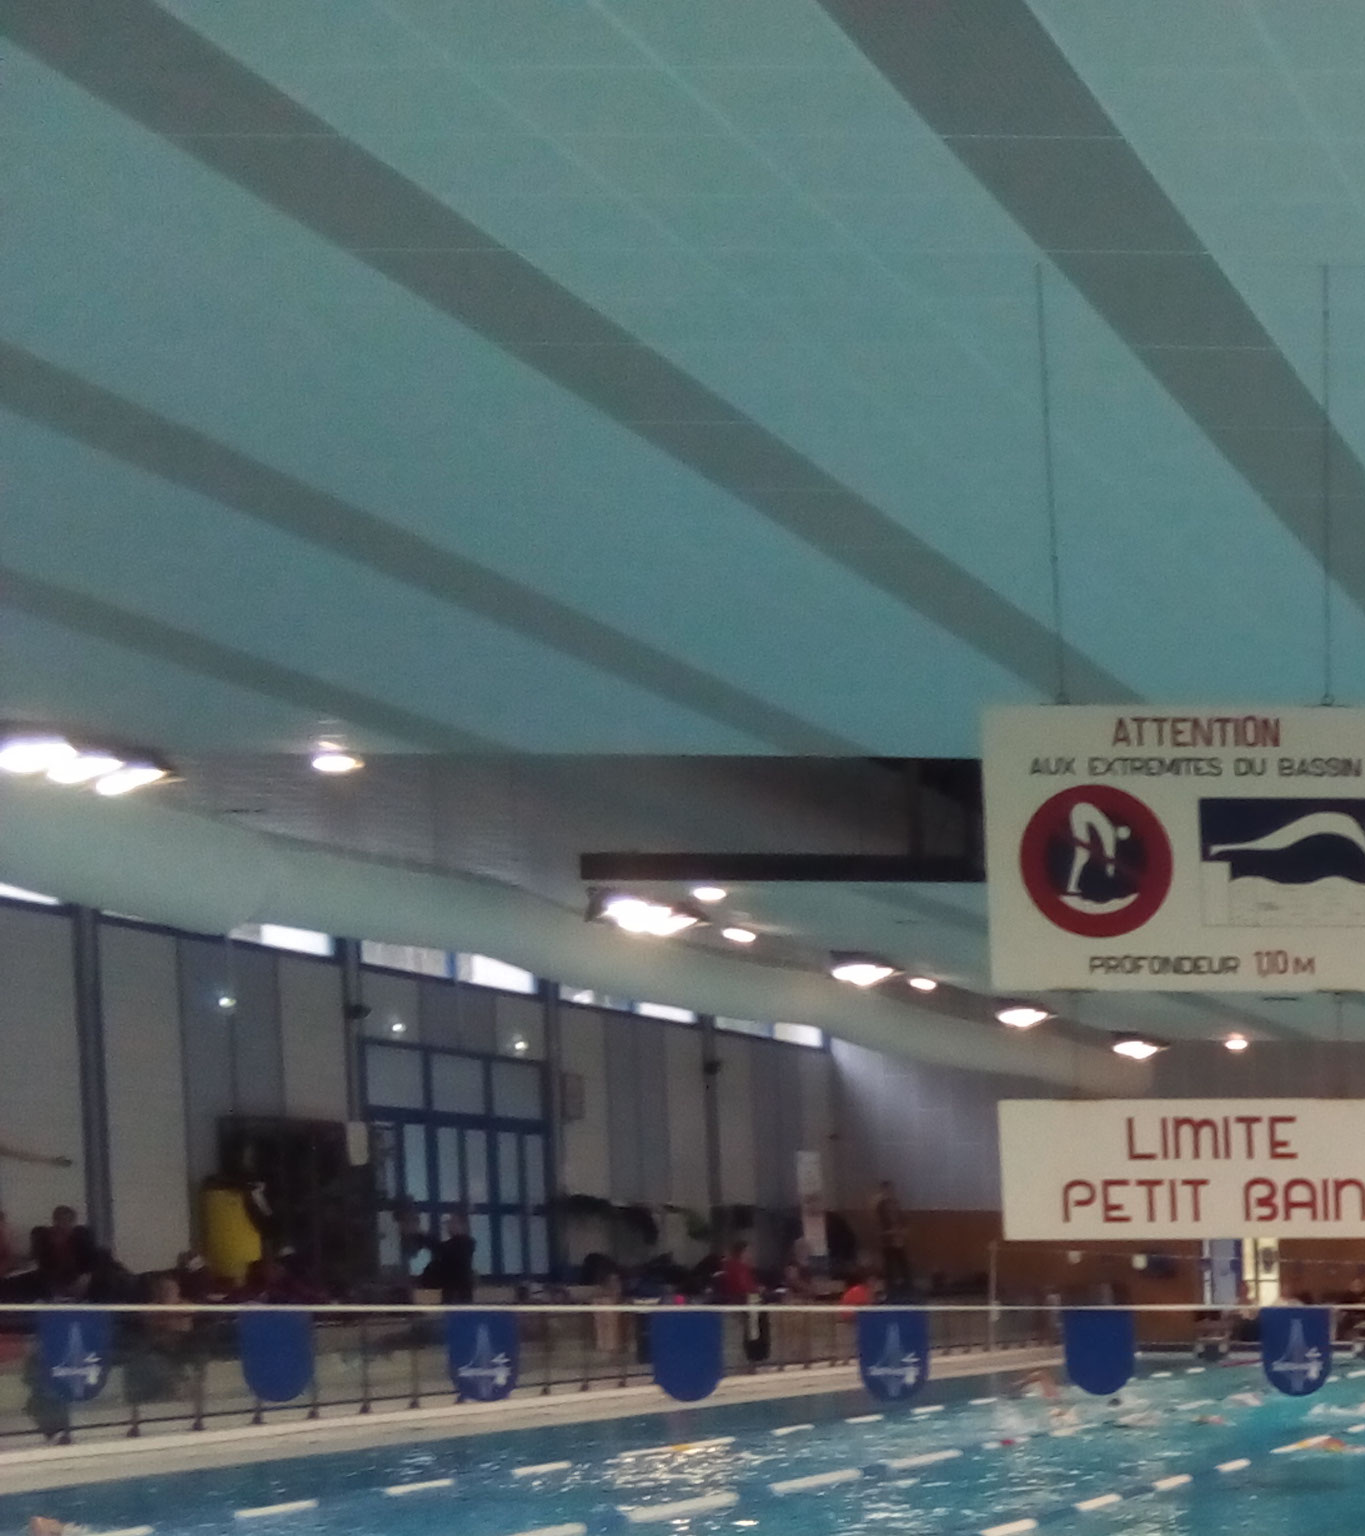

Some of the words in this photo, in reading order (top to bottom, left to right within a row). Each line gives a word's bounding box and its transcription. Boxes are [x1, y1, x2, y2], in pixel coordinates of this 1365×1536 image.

[1111, 715, 1281, 748] ATTENTION
[1029, 757, 1077, 777] AUX
[1088, 757, 1224, 777] EXTREMITES
[1234, 757, 1267, 777] DU
[1276, 757, 1363, 778] BASSIN
[1089, 955, 1241, 975] PROFONDEUR
[1126, 1115, 1299, 1160] LIMITE
[1061, 1178, 1210, 1223] PETIT
